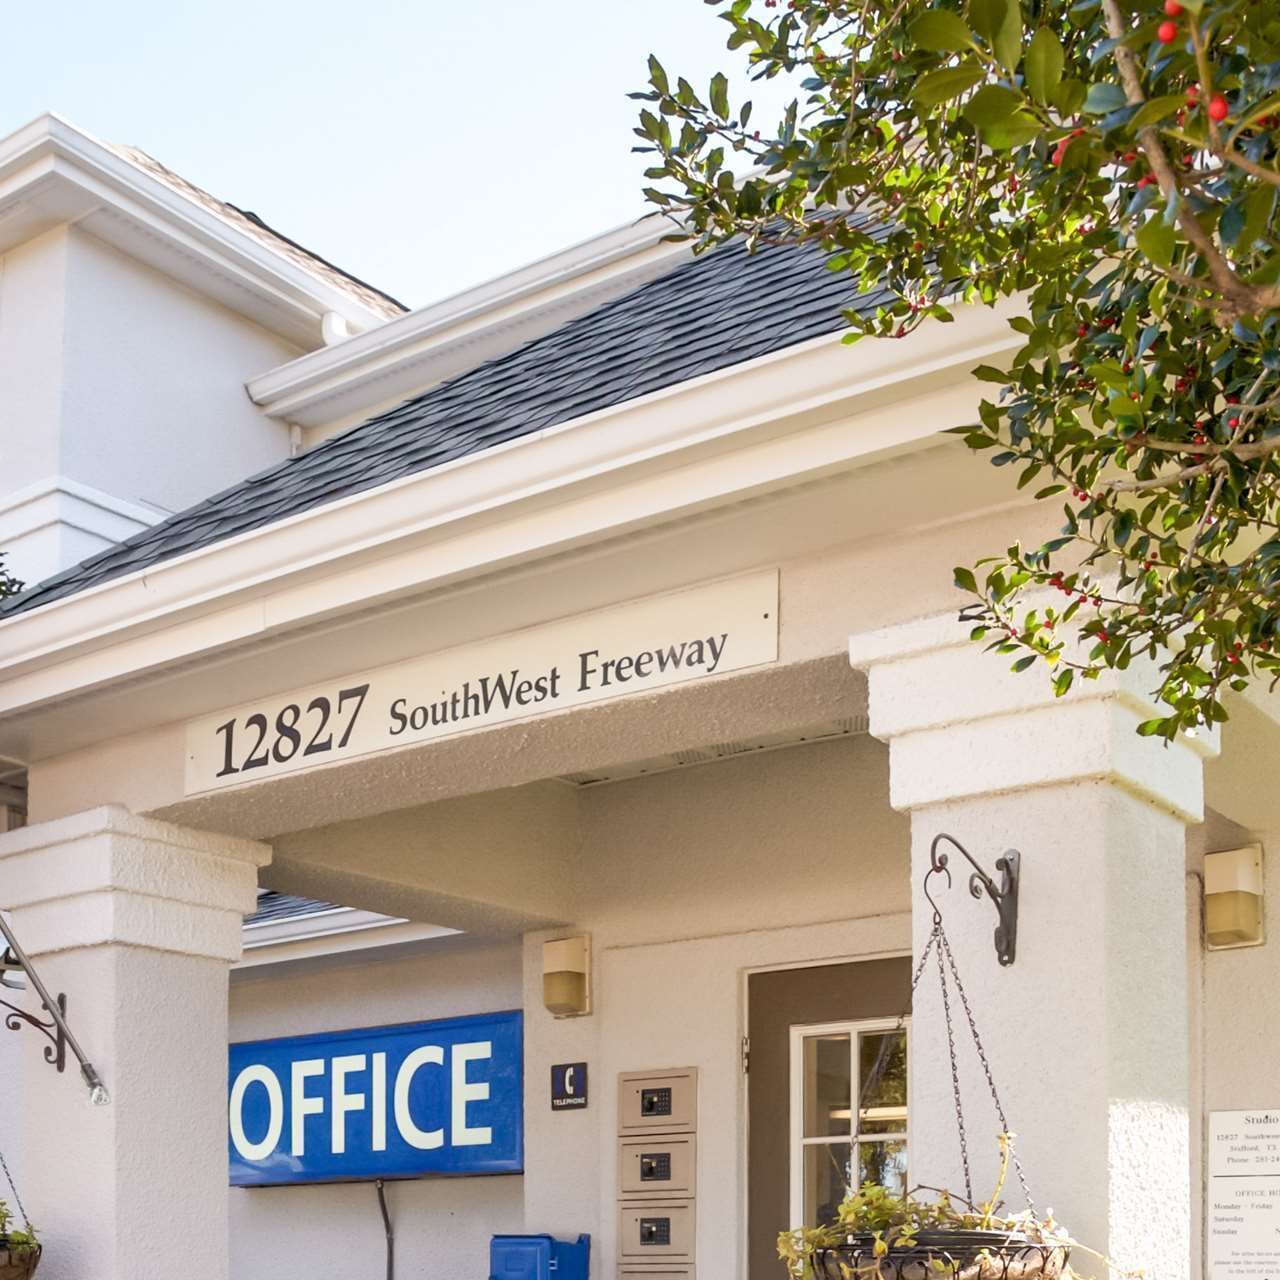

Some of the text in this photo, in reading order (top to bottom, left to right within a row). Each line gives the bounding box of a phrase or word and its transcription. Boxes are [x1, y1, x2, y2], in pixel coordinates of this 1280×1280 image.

[215, 633, 728, 778] 12827 SouthWest Freeway
[229, 1040, 492, 1161] OFFICE
[1244, 1114, 1279, 1125] Studio
[1235, 1189, 1266, 1198] OFFICE
